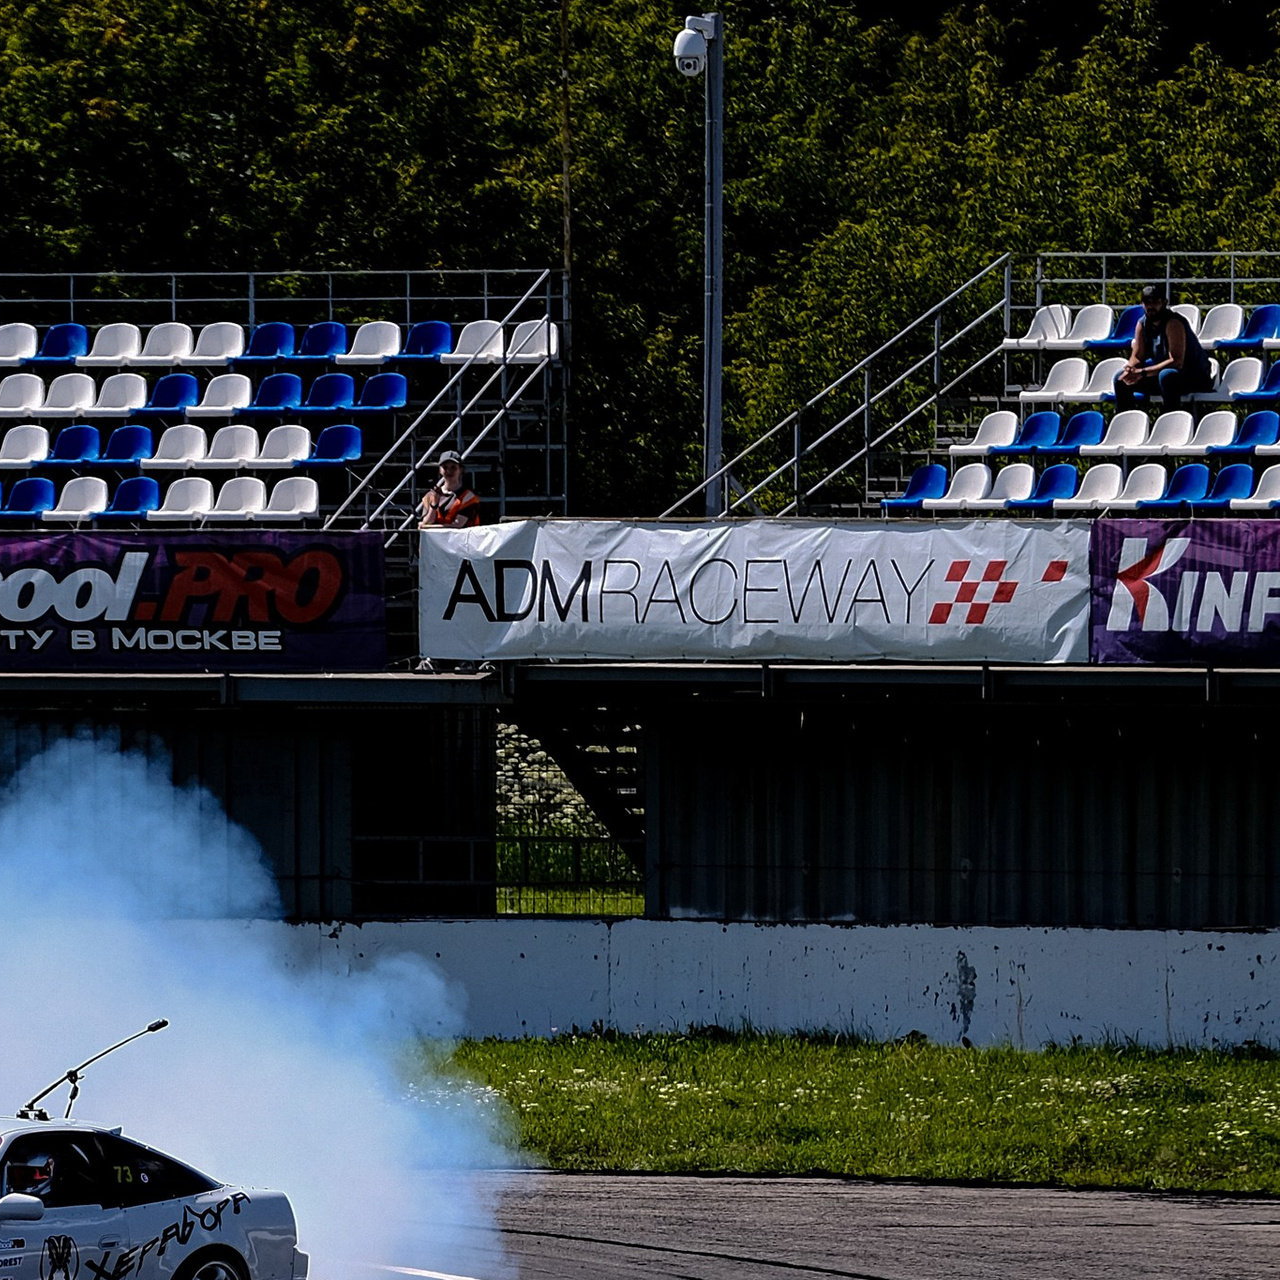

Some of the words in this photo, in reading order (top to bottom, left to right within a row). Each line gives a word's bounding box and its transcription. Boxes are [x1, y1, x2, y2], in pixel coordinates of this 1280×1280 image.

[71, 630, 96, 651] В
[111, 629, 283, 652] МОСКВЕ
[113, 1166, 133, 1183] 73
